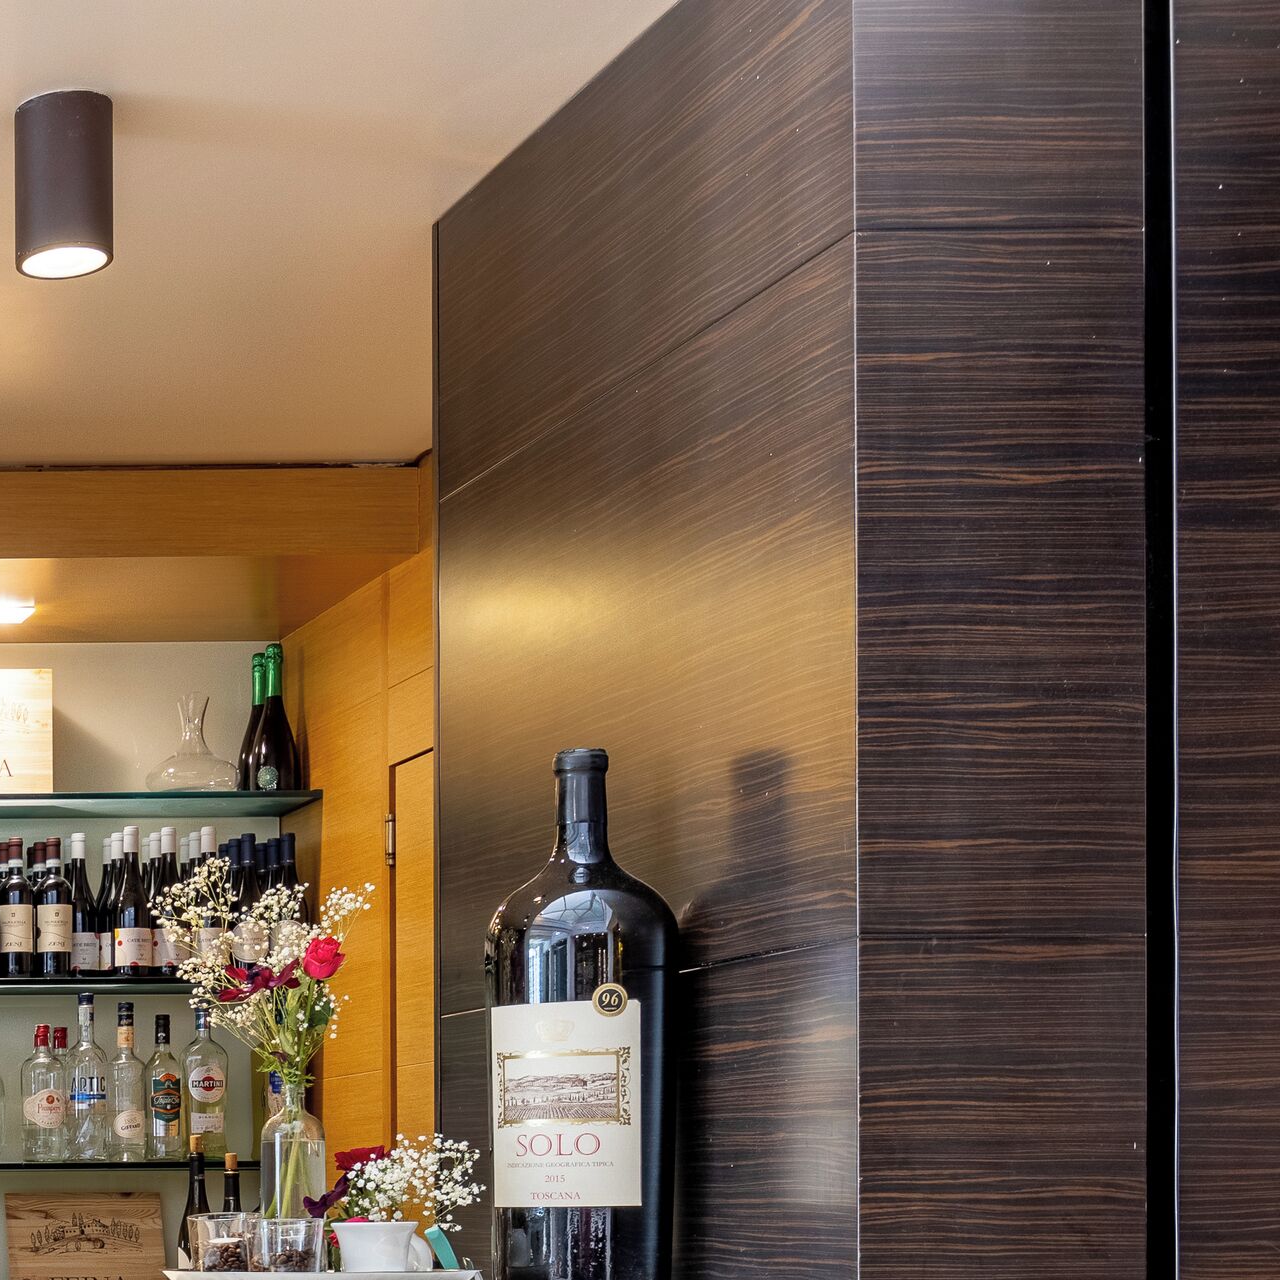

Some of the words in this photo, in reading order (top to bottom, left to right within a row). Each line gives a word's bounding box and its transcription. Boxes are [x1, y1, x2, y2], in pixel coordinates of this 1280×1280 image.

[601, 992, 619, 1007] 96
[71, 1076, 106, 1093] ARTIC
[192, 1080, 223, 1088] MARTINI
[516, 1132, 601, 1157] SOLO
[544, 1175, 566, 1183] 2015
[530, 1191, 581, 1200] TOSCANA
